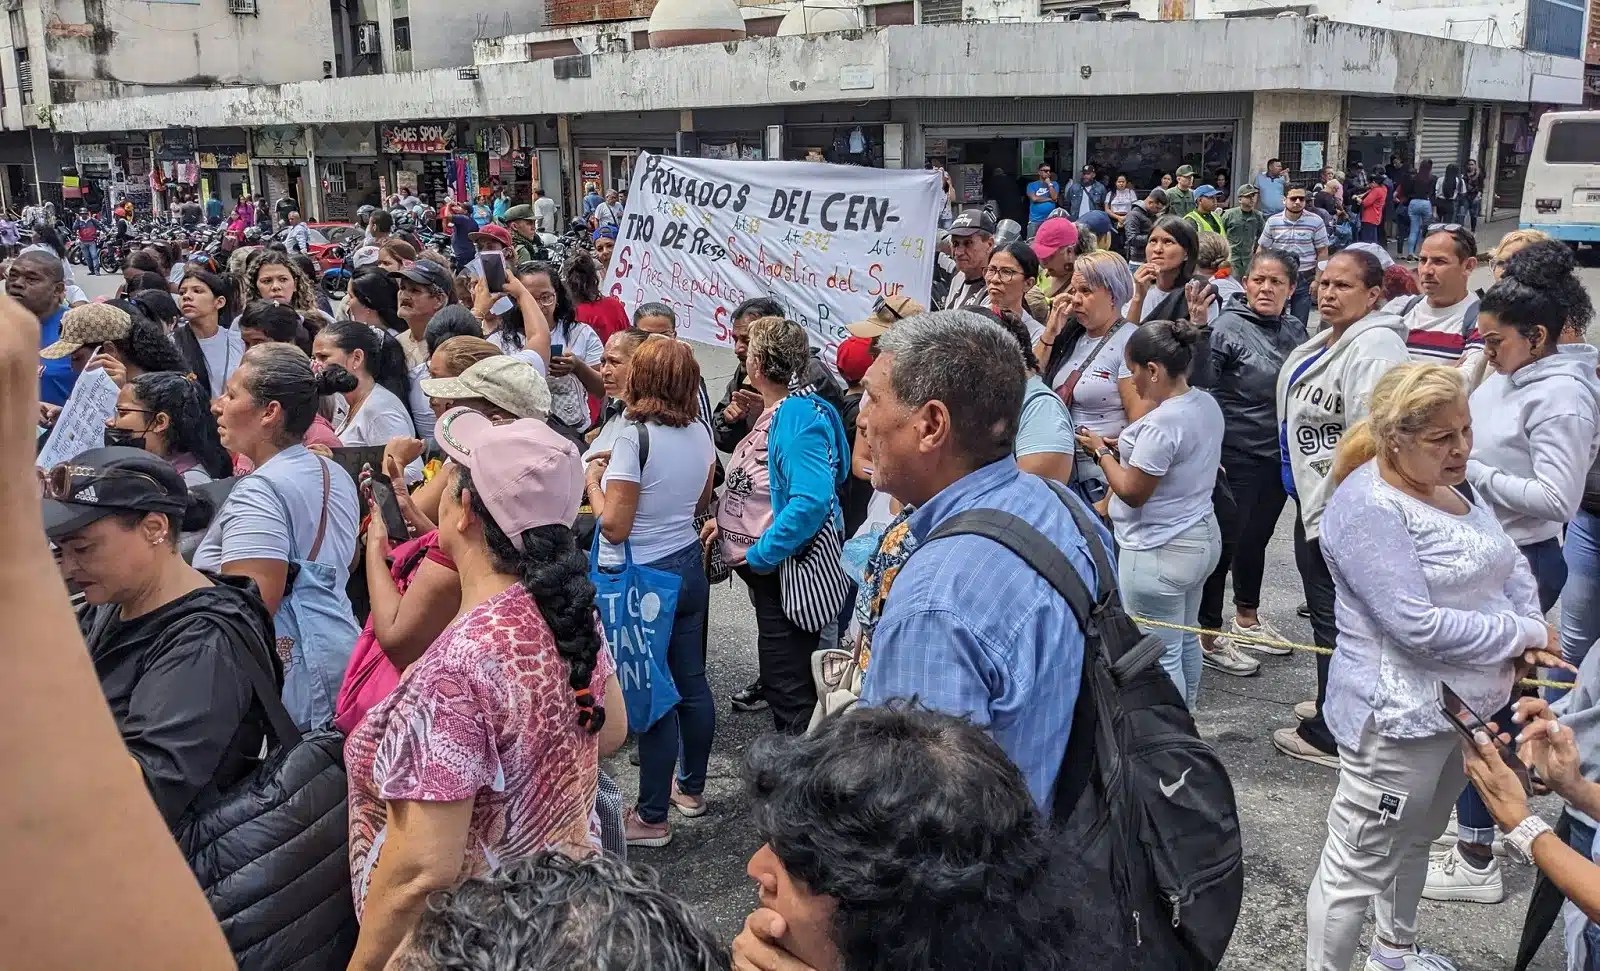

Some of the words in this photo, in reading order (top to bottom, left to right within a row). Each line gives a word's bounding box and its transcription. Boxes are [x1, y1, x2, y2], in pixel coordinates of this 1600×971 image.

[394, 126, 418, 142] SHOES
[768, 188, 812, 225] DEL
[820, 192, 900, 233] CEN-
[625, 213, 655, 243] TRO
[659, 221, 688, 250] DE
[615, 245, 633, 279] Sr
[727, 236, 751, 272] San
[826, 265, 859, 295] del
[866, 263, 905, 297] Sur
[1296, 422, 1343, 456] 96
[74, 493, 99, 503] adidas
[724, 531, 756, 546] FASHION
[627, 585, 661, 623] GO
